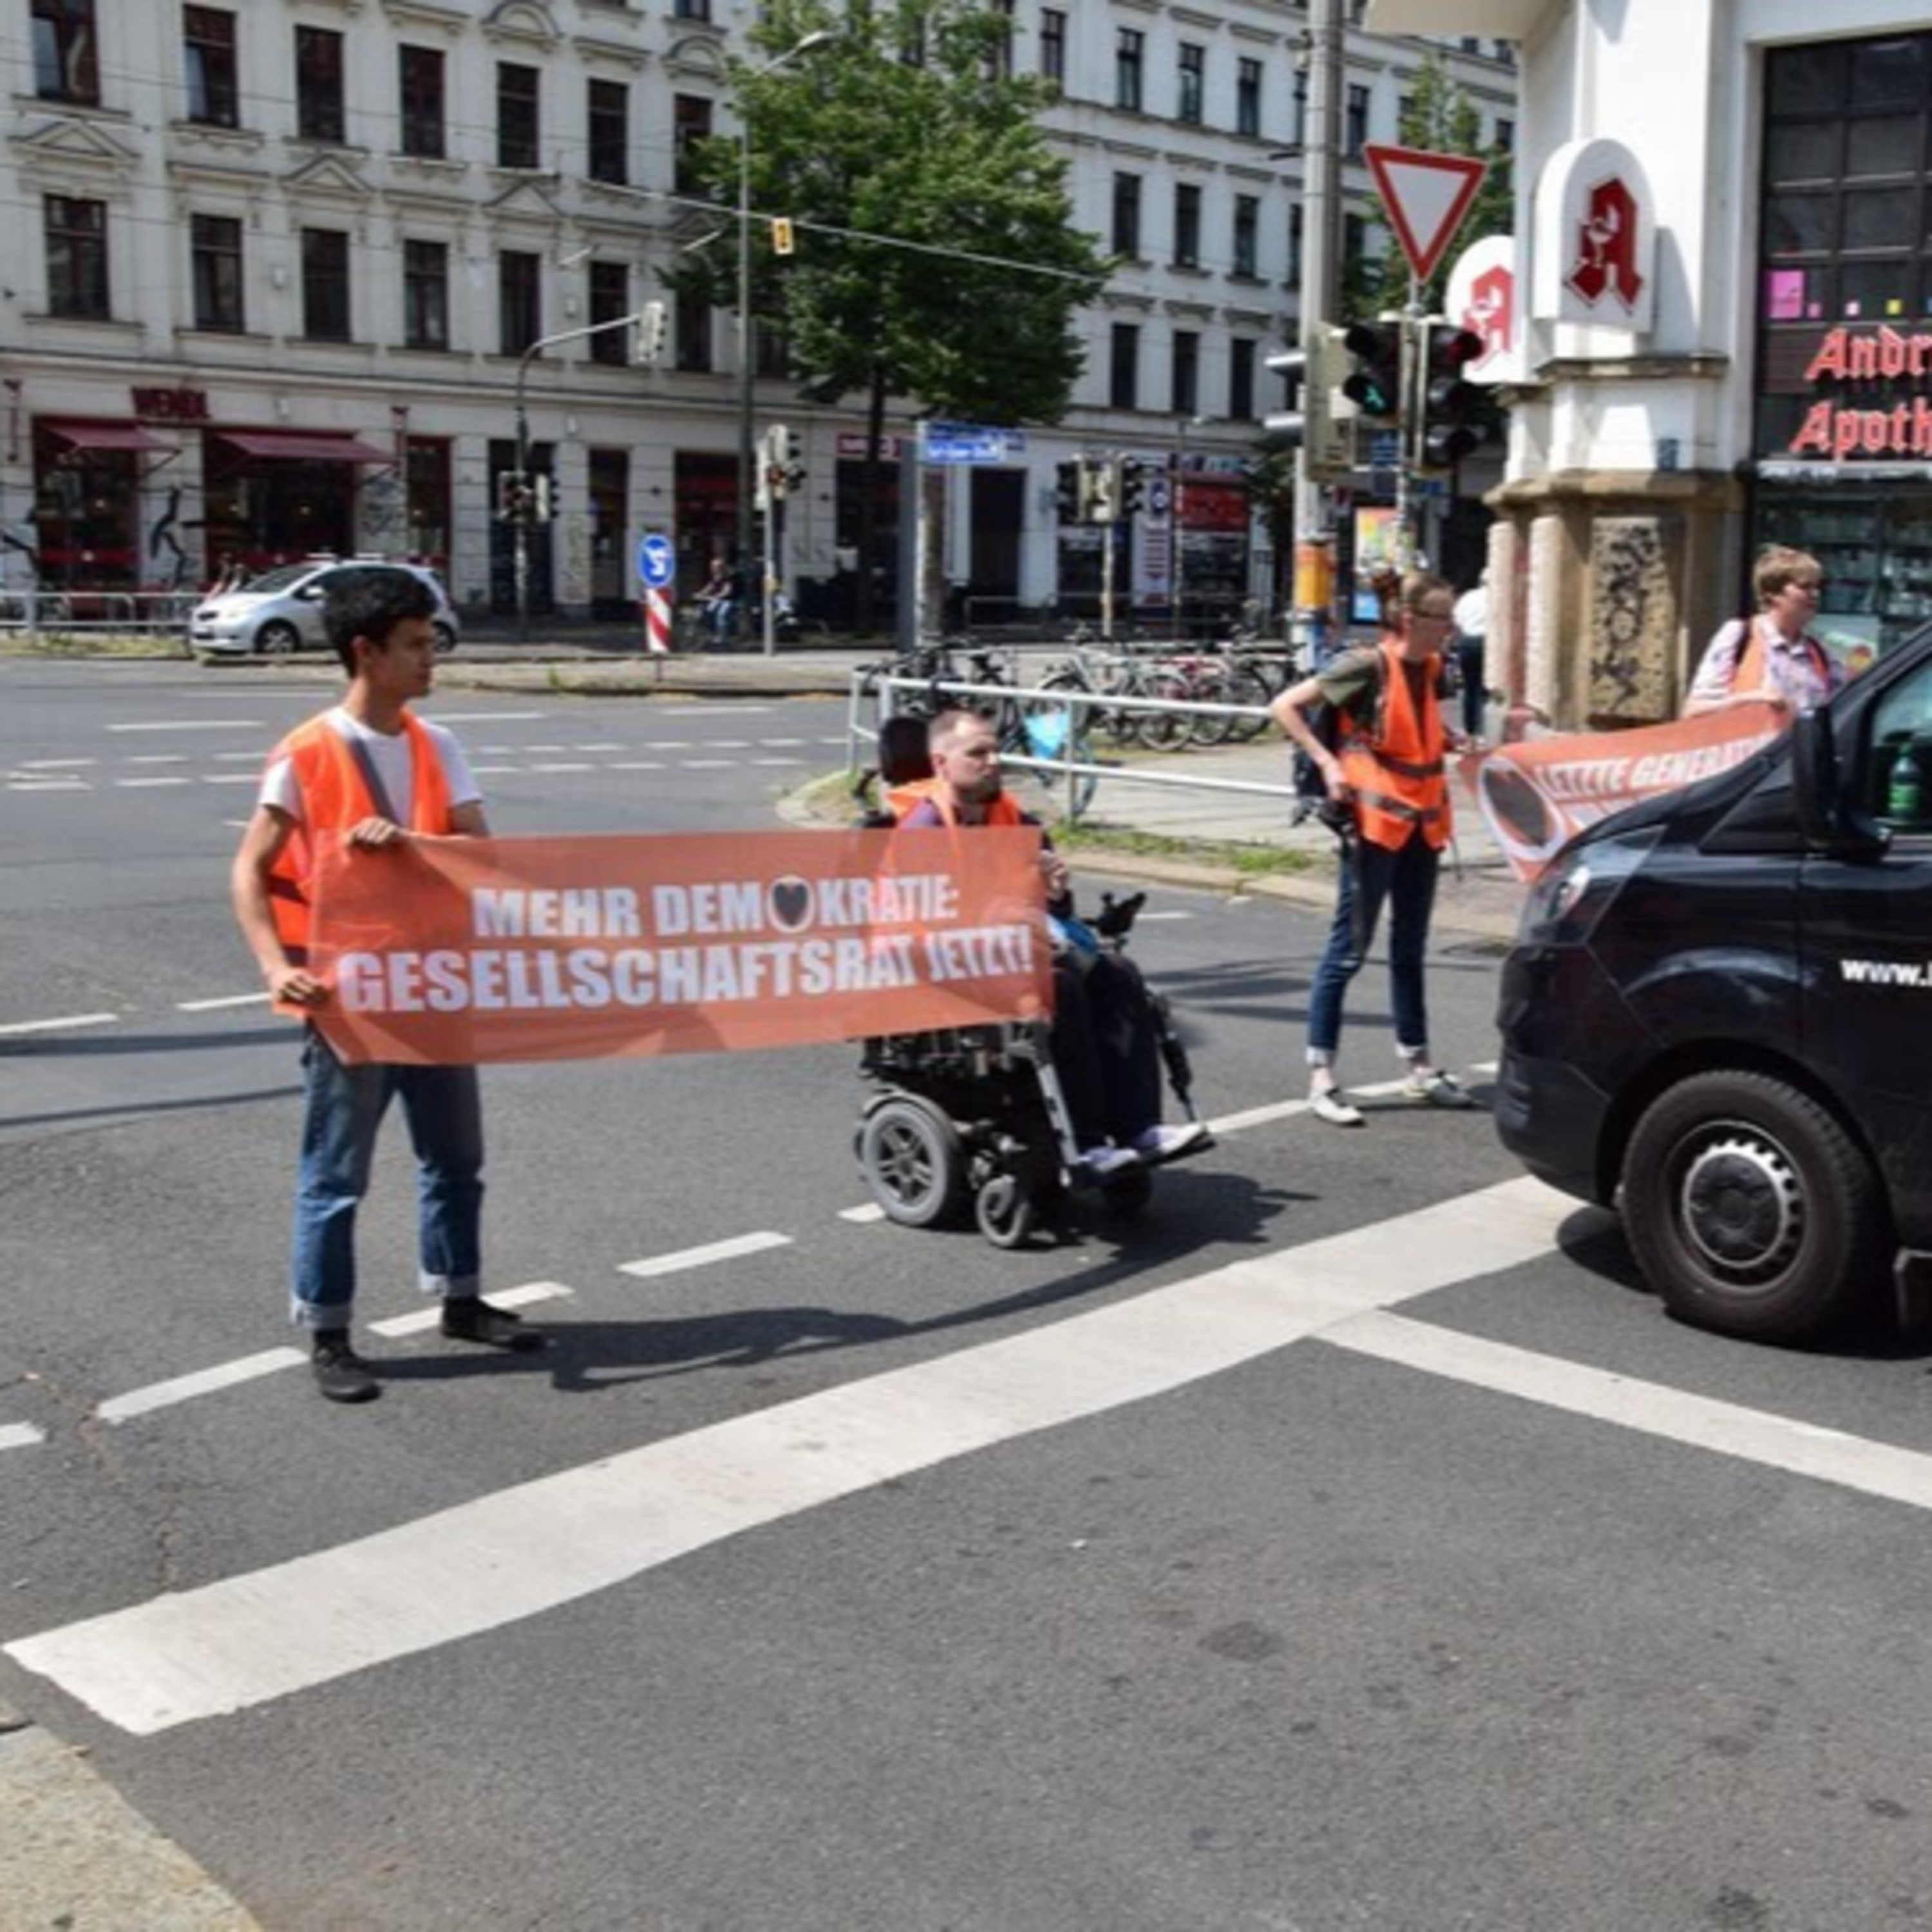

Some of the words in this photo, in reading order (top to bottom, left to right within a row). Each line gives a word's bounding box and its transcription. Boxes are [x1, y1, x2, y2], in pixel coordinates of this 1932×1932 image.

[1805, 325, 1932, 379] Andr
[1788, 396, 1932, 462] Apoth
[1534, 757, 1632, 799] LETZTE
[473, 887, 641, 938] MEHR
[337, 935, 917, 1012] GESELLSCHAFTSRAT
[925, 923, 1034, 981] JETZT!
